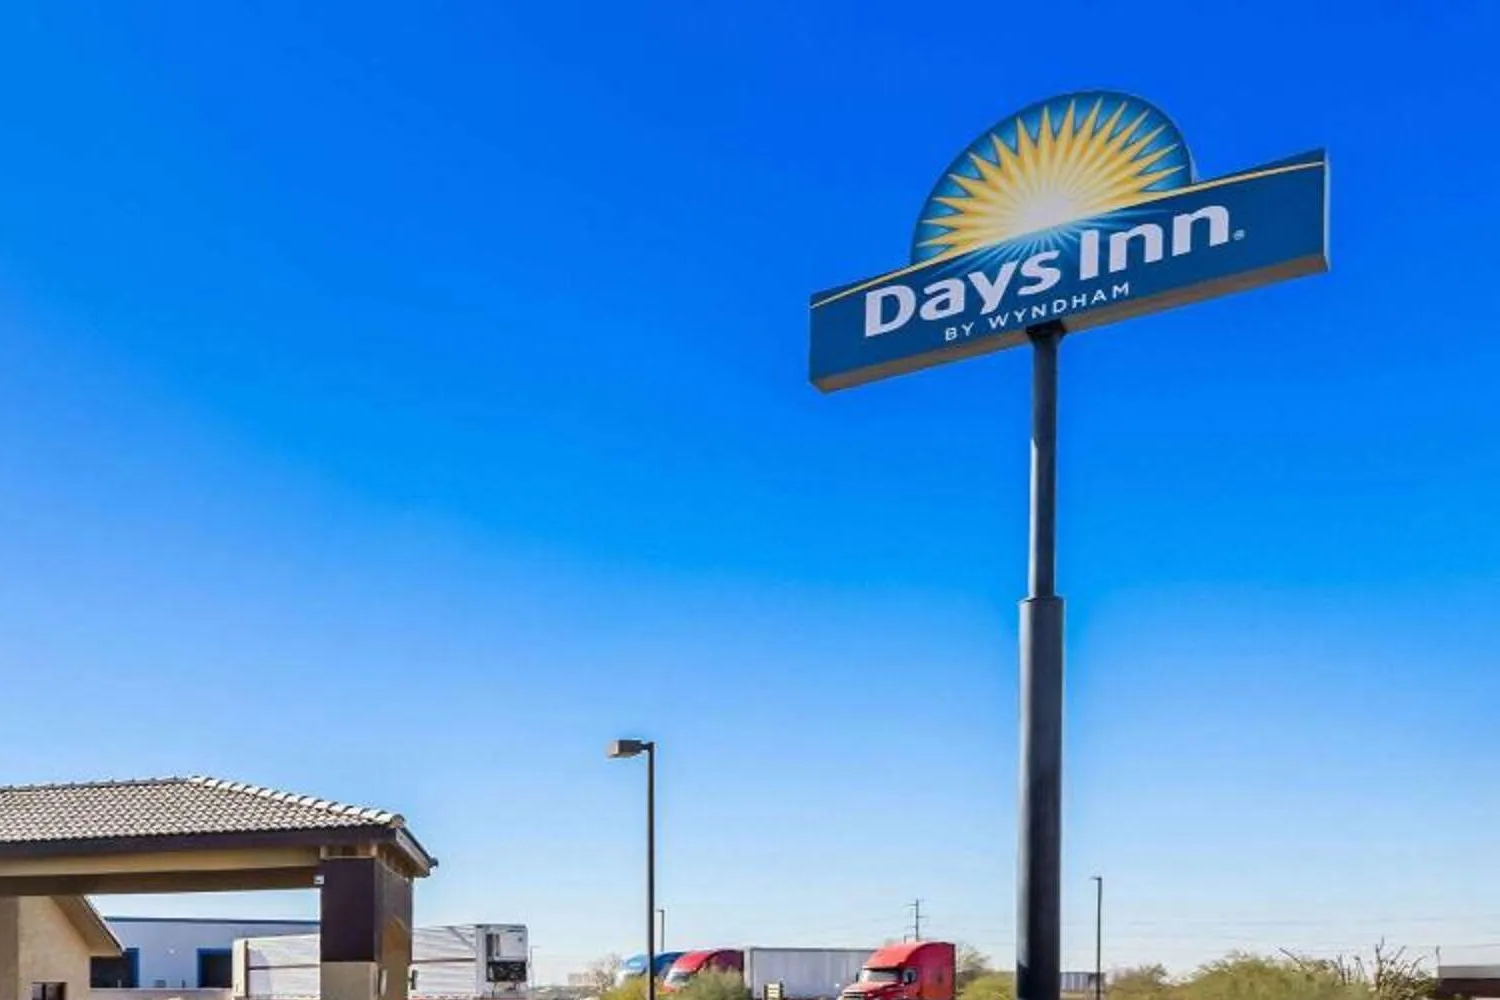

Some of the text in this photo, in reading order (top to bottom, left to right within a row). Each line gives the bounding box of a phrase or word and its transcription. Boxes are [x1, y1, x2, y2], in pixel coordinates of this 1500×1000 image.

[864, 204, 1230, 337] Days Inn
[944, 281, 1131, 342] BY WYNDHAM
